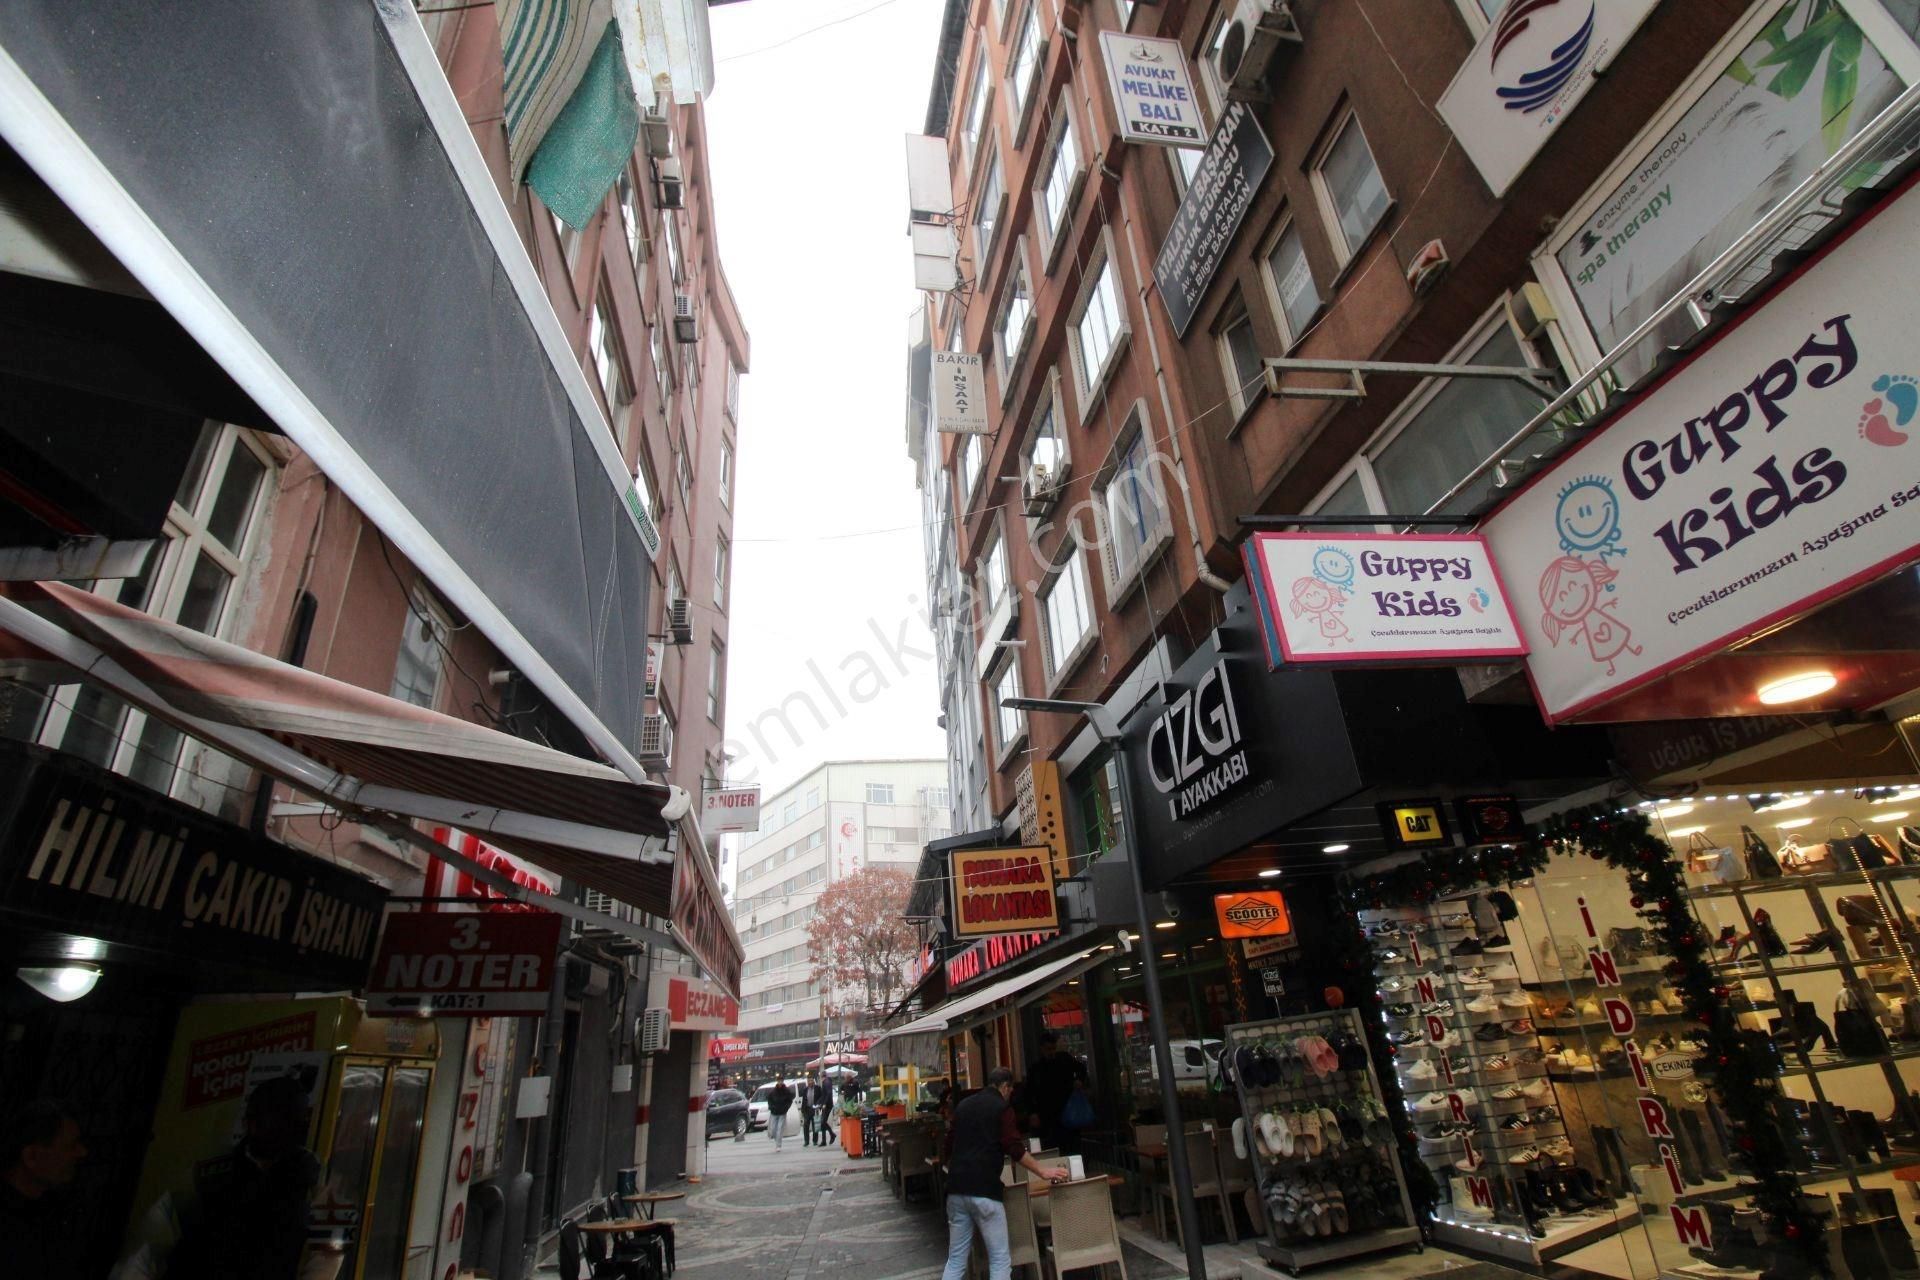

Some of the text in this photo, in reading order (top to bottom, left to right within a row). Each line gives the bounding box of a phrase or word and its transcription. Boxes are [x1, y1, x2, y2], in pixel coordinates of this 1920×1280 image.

[1124, 64, 1176, 81] AVUKAT
[1121, 80, 1188, 101] MELİKE
[1139, 102, 1182, 122] BALİ
[1139, 122, 1169, 135] KAT
[1183, 127, 1192, 137] 2
[1157, 101, 1245, 287] ATALAY & BAŞARAN
[1214, 165, 1246, 225] ATALAY
[1596, 184, 1639, 230] enzyme
[1639, 132, 1688, 183] therapy
[1172, 143, 1240, 282] HUKUK BÜROSU
[1195, 256, 1214, 286] Bilge
[1211, 182, 1251, 254] BAŞARAN
[1576, 252, 1607, 286] spa
[1605, 183, 1672, 256] therapy
[936, 353, 979, 366] BAKIR
[1622, 314, 1858, 501] Guppy
[1653, 447, 1847, 575] Kids
[1360, 550, 1472, 582] Guppy
[1667, 551, 1799, 627] Çocuklarımızın
[1801, 503, 1889, 556] Ayağına
[1371, 590, 1462, 618] Kids
[1181, 750, 1249, 816] AYAKKABI
[1405, 814, 1432, 833] CAT
[24, 796, 190, 912] HİLMİ
[182, 848, 297, 942] ÇAKIR
[290, 875, 375, 961] İŞHANI
[962, 856, 1045, 887] BUHARA
[961, 889, 1053, 924] LOKANTASI
[1225, 907, 1280, 920] SCOOTER
[449, 917, 492, 950] 3.
[384, 954, 543, 989] NOTER
[430, 994, 487, 1009] KAT:1
[686, 990, 727, 1018] ECZANE
